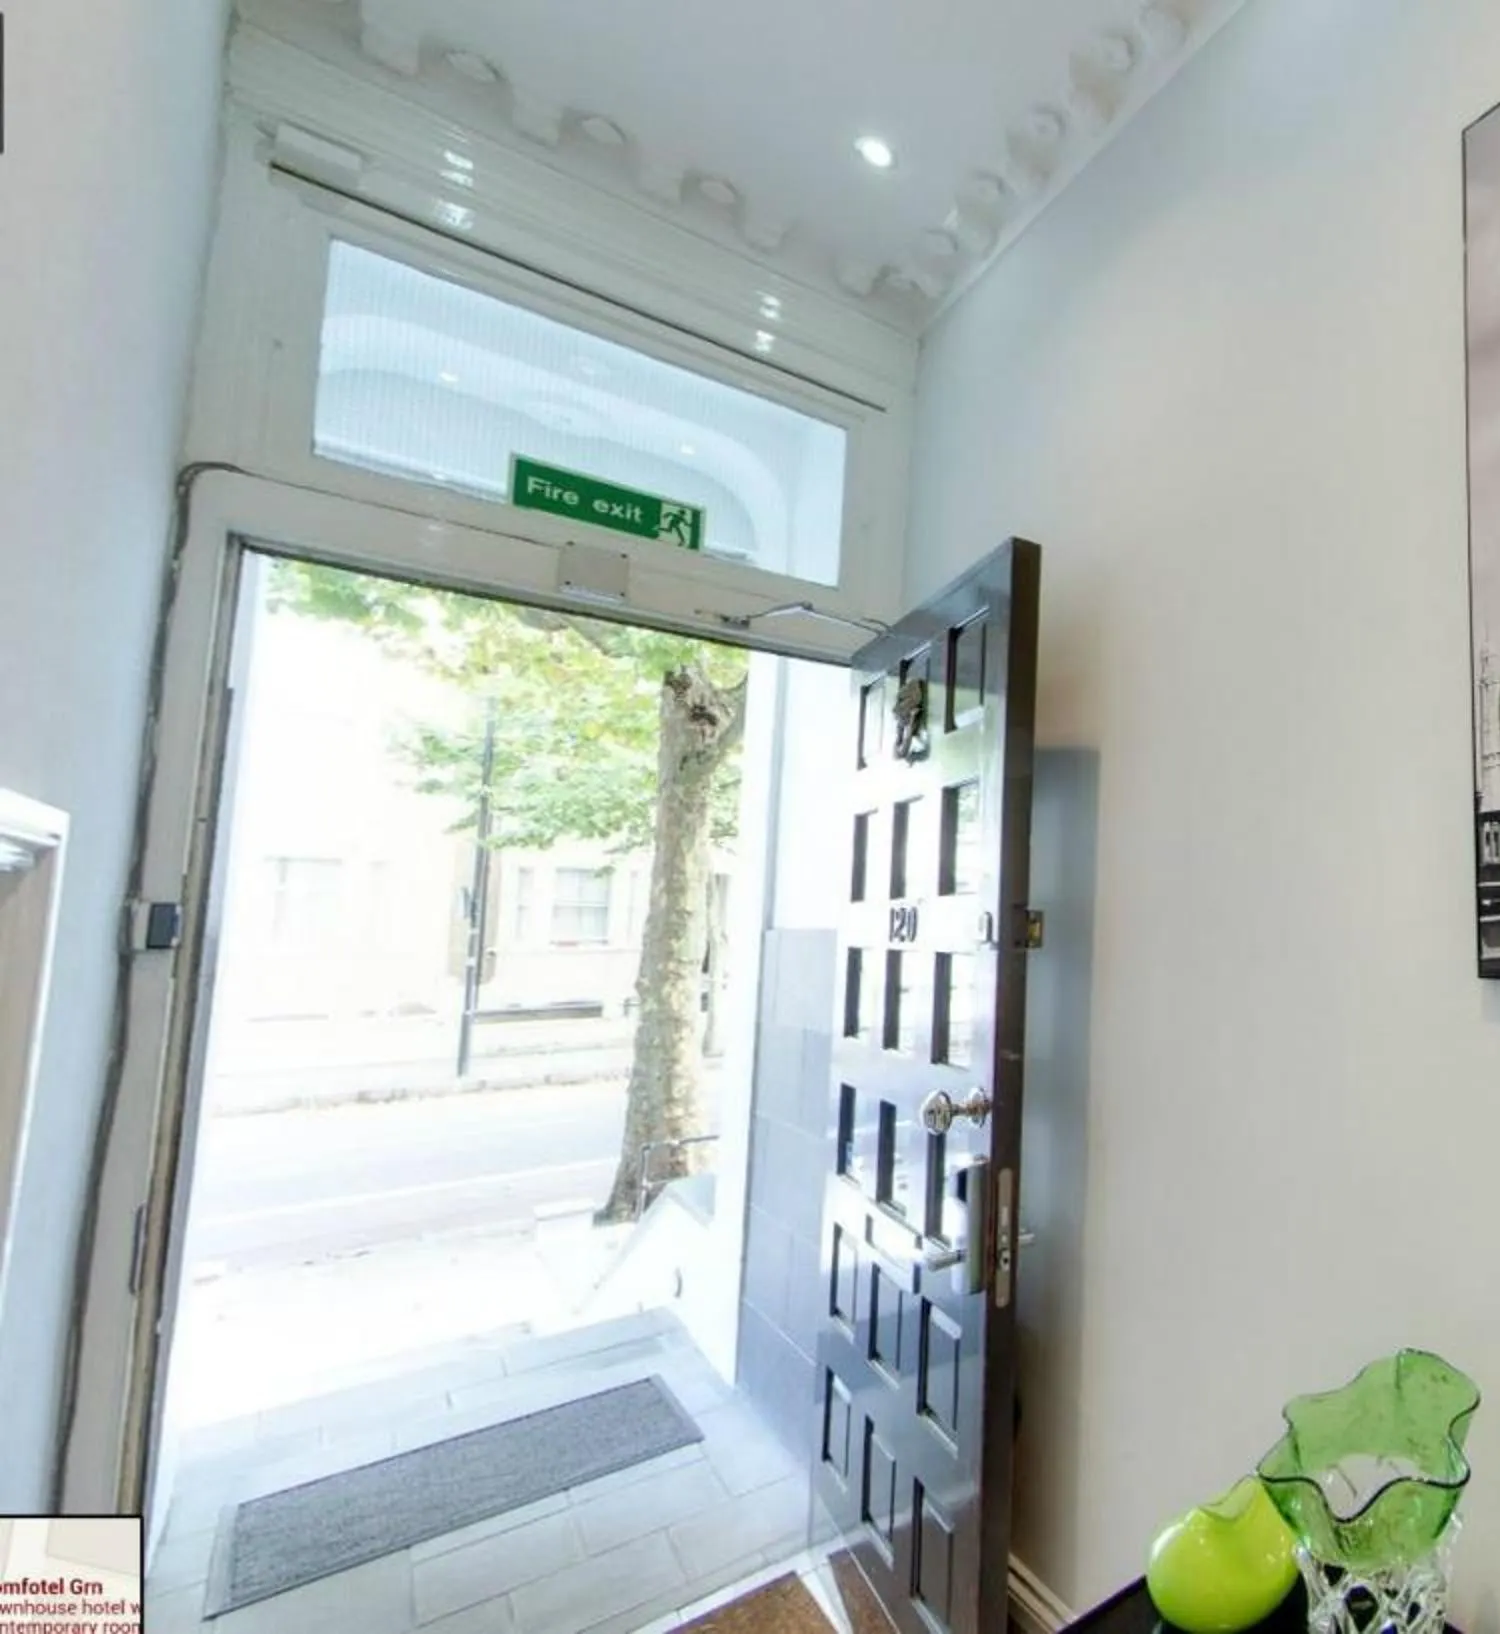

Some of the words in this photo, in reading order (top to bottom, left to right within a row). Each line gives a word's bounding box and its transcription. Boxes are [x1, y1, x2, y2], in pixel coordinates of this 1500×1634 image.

[526, 475, 580, 506] Fire
[591, 498, 644, 523] exit
[889, 906, 918, 943] 120
